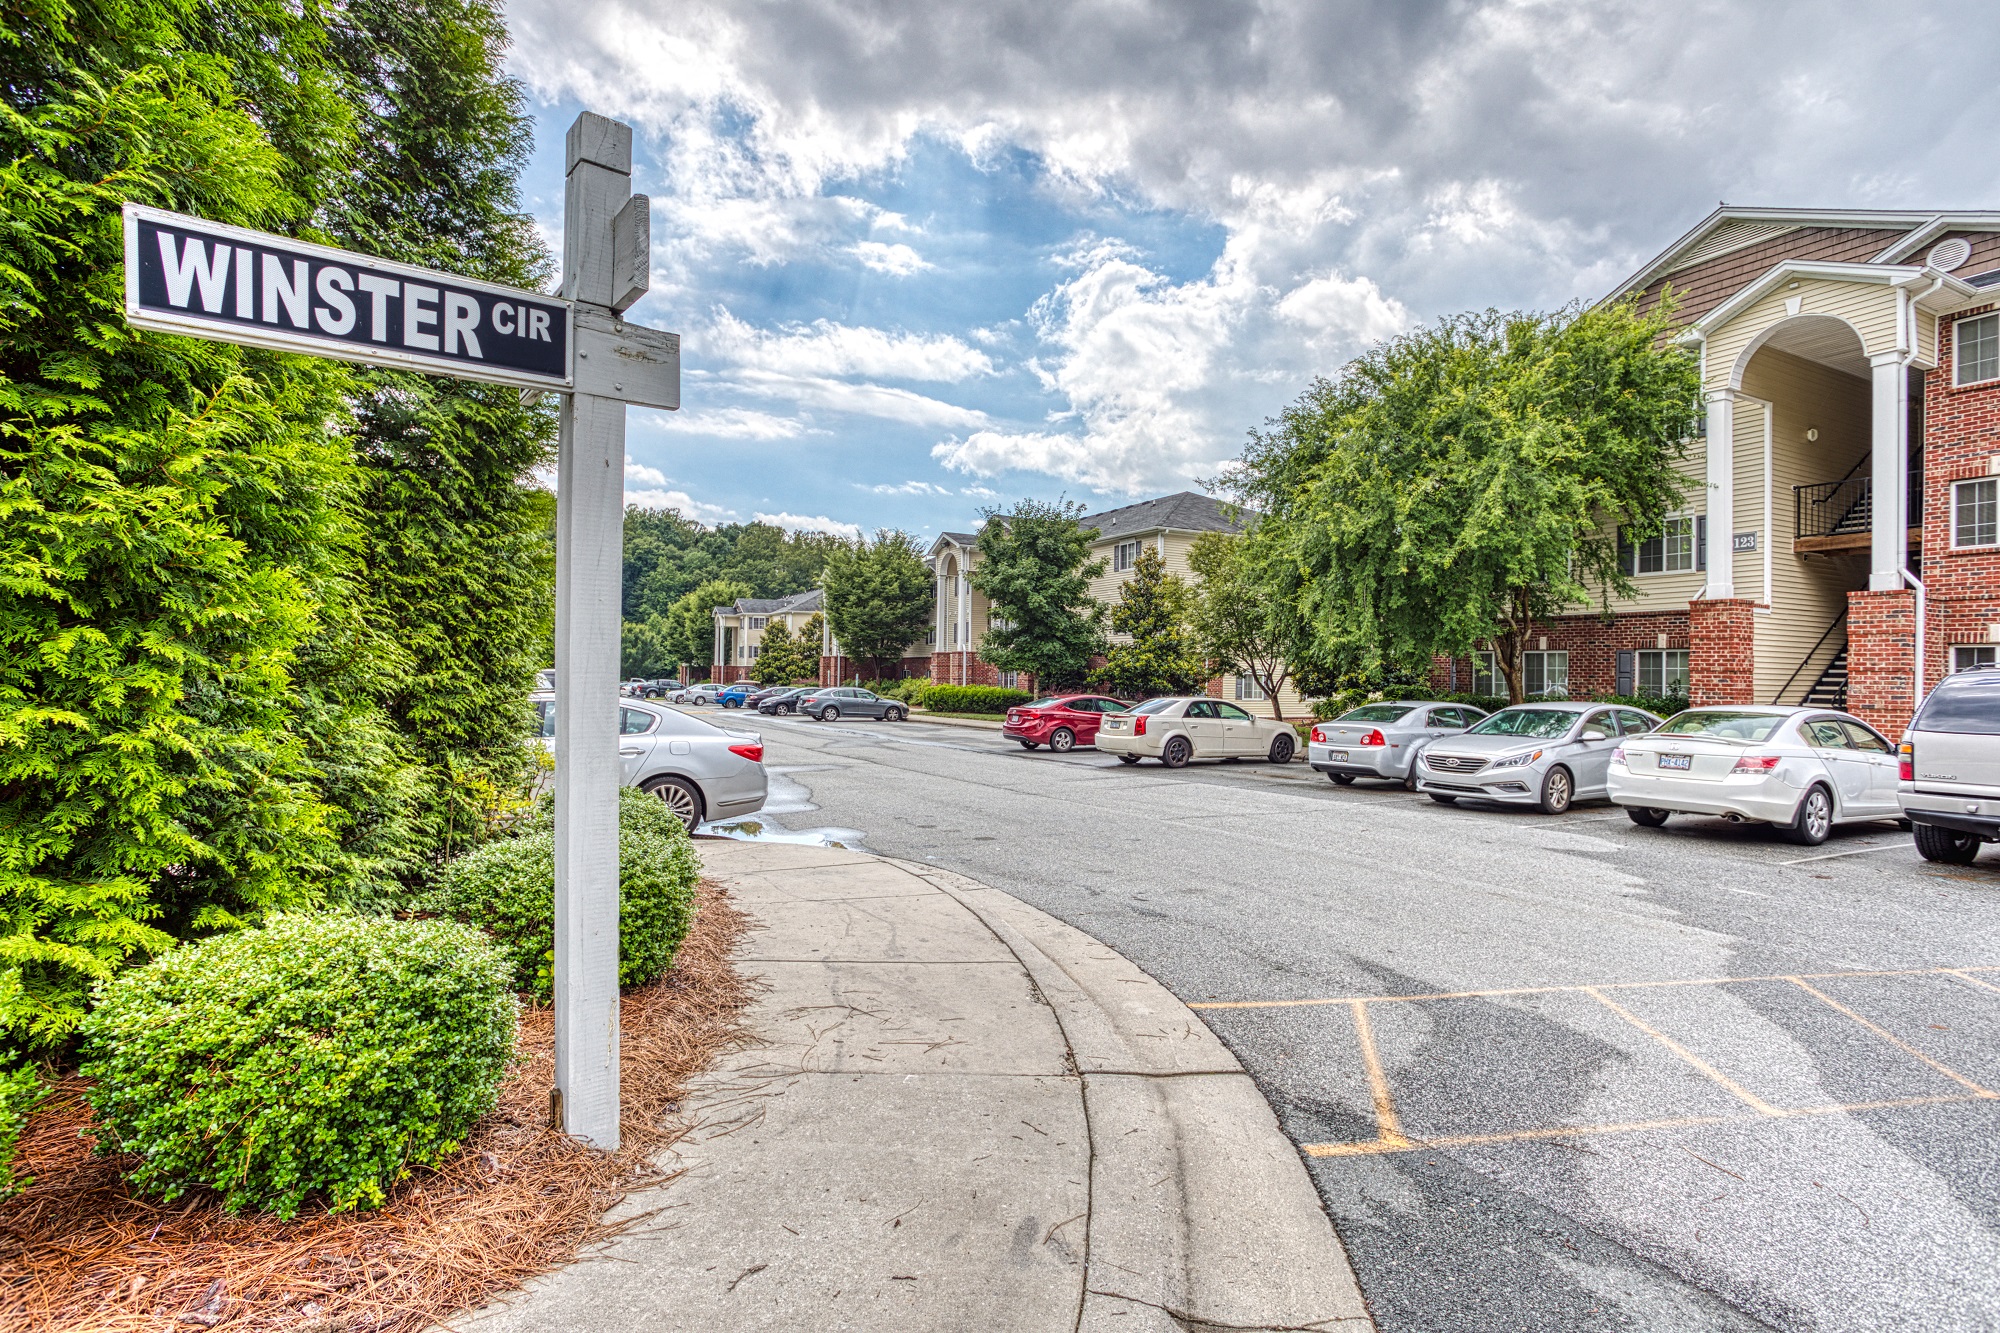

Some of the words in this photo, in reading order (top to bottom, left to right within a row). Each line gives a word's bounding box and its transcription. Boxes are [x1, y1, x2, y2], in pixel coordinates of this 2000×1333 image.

[156, 231, 484, 359] WINSTER
[491, 302, 551, 343] CIR
[1733, 535, 1755, 549] 123
